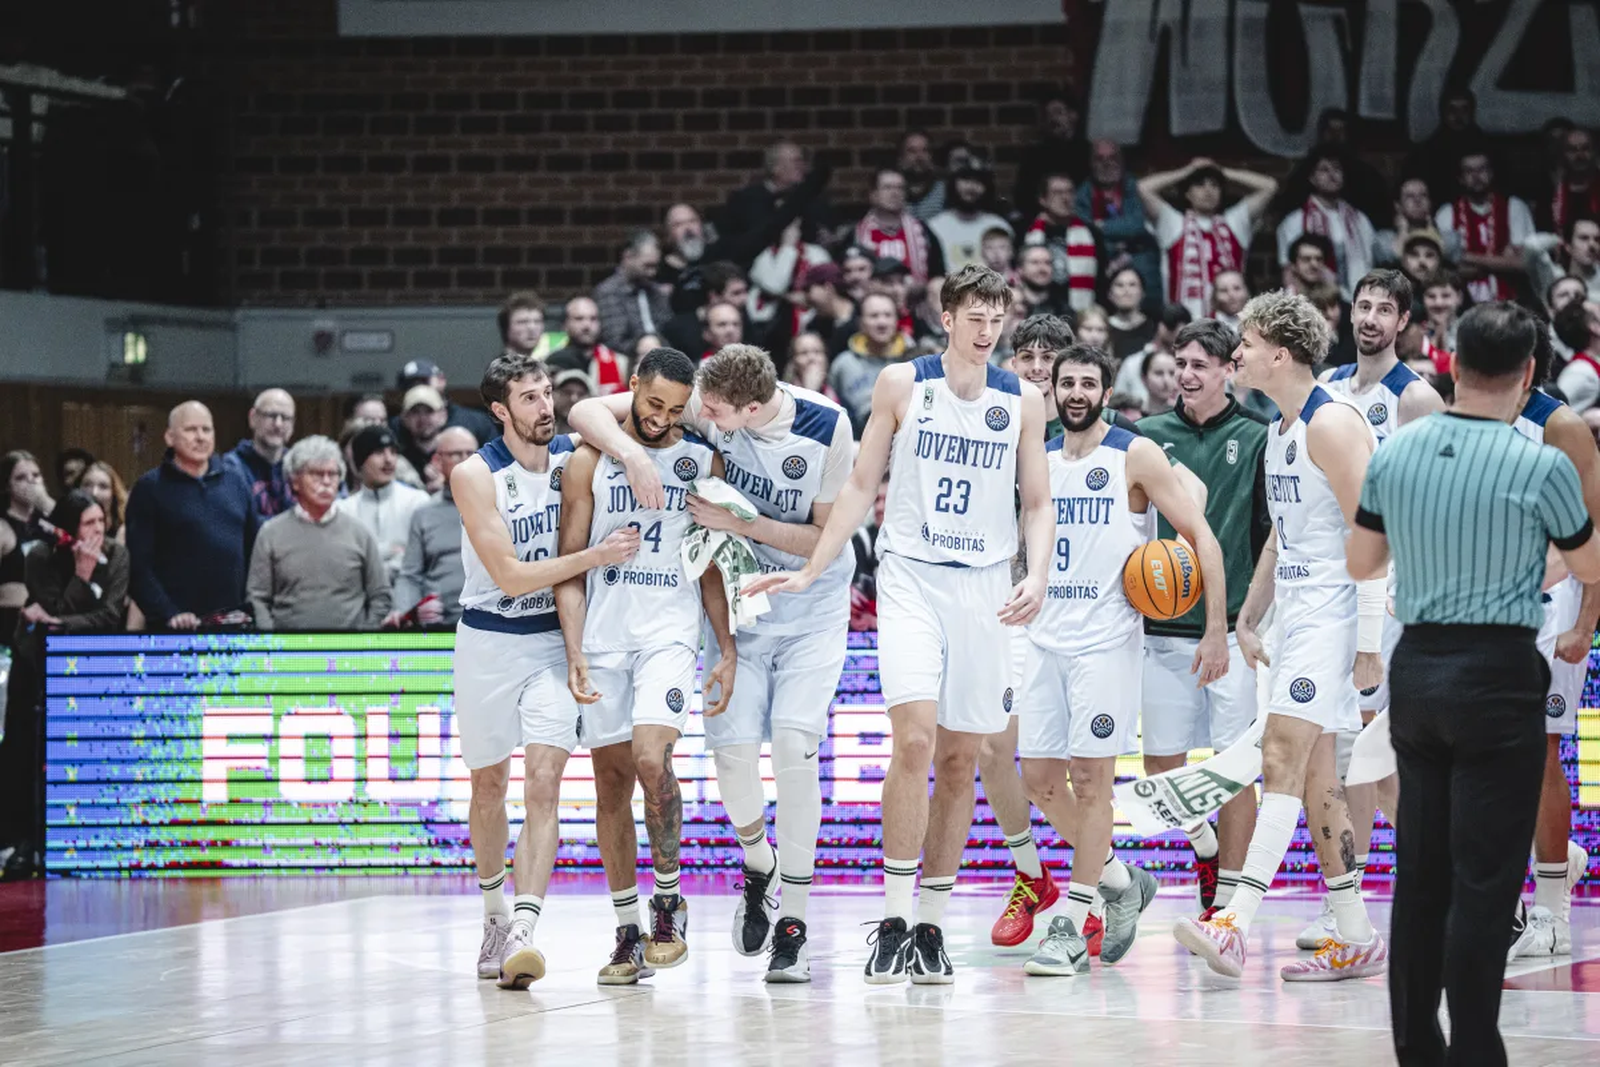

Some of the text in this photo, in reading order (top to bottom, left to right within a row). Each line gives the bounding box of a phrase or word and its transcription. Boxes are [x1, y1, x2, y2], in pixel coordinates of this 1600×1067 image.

[914, 429, 1008, 470] JOVENTUT
[935, 477, 971, 515] 23
[1052, 497, 1114, 525] ENTUT
[931, 533, 985, 552] PROBITAS
[1057, 537, 1070, 571] 9
[622, 570, 678, 588] PROBITAS
[1173, 547, 1193, 598] Wilson
[1047, 585, 1099, 600] PROBITAS
